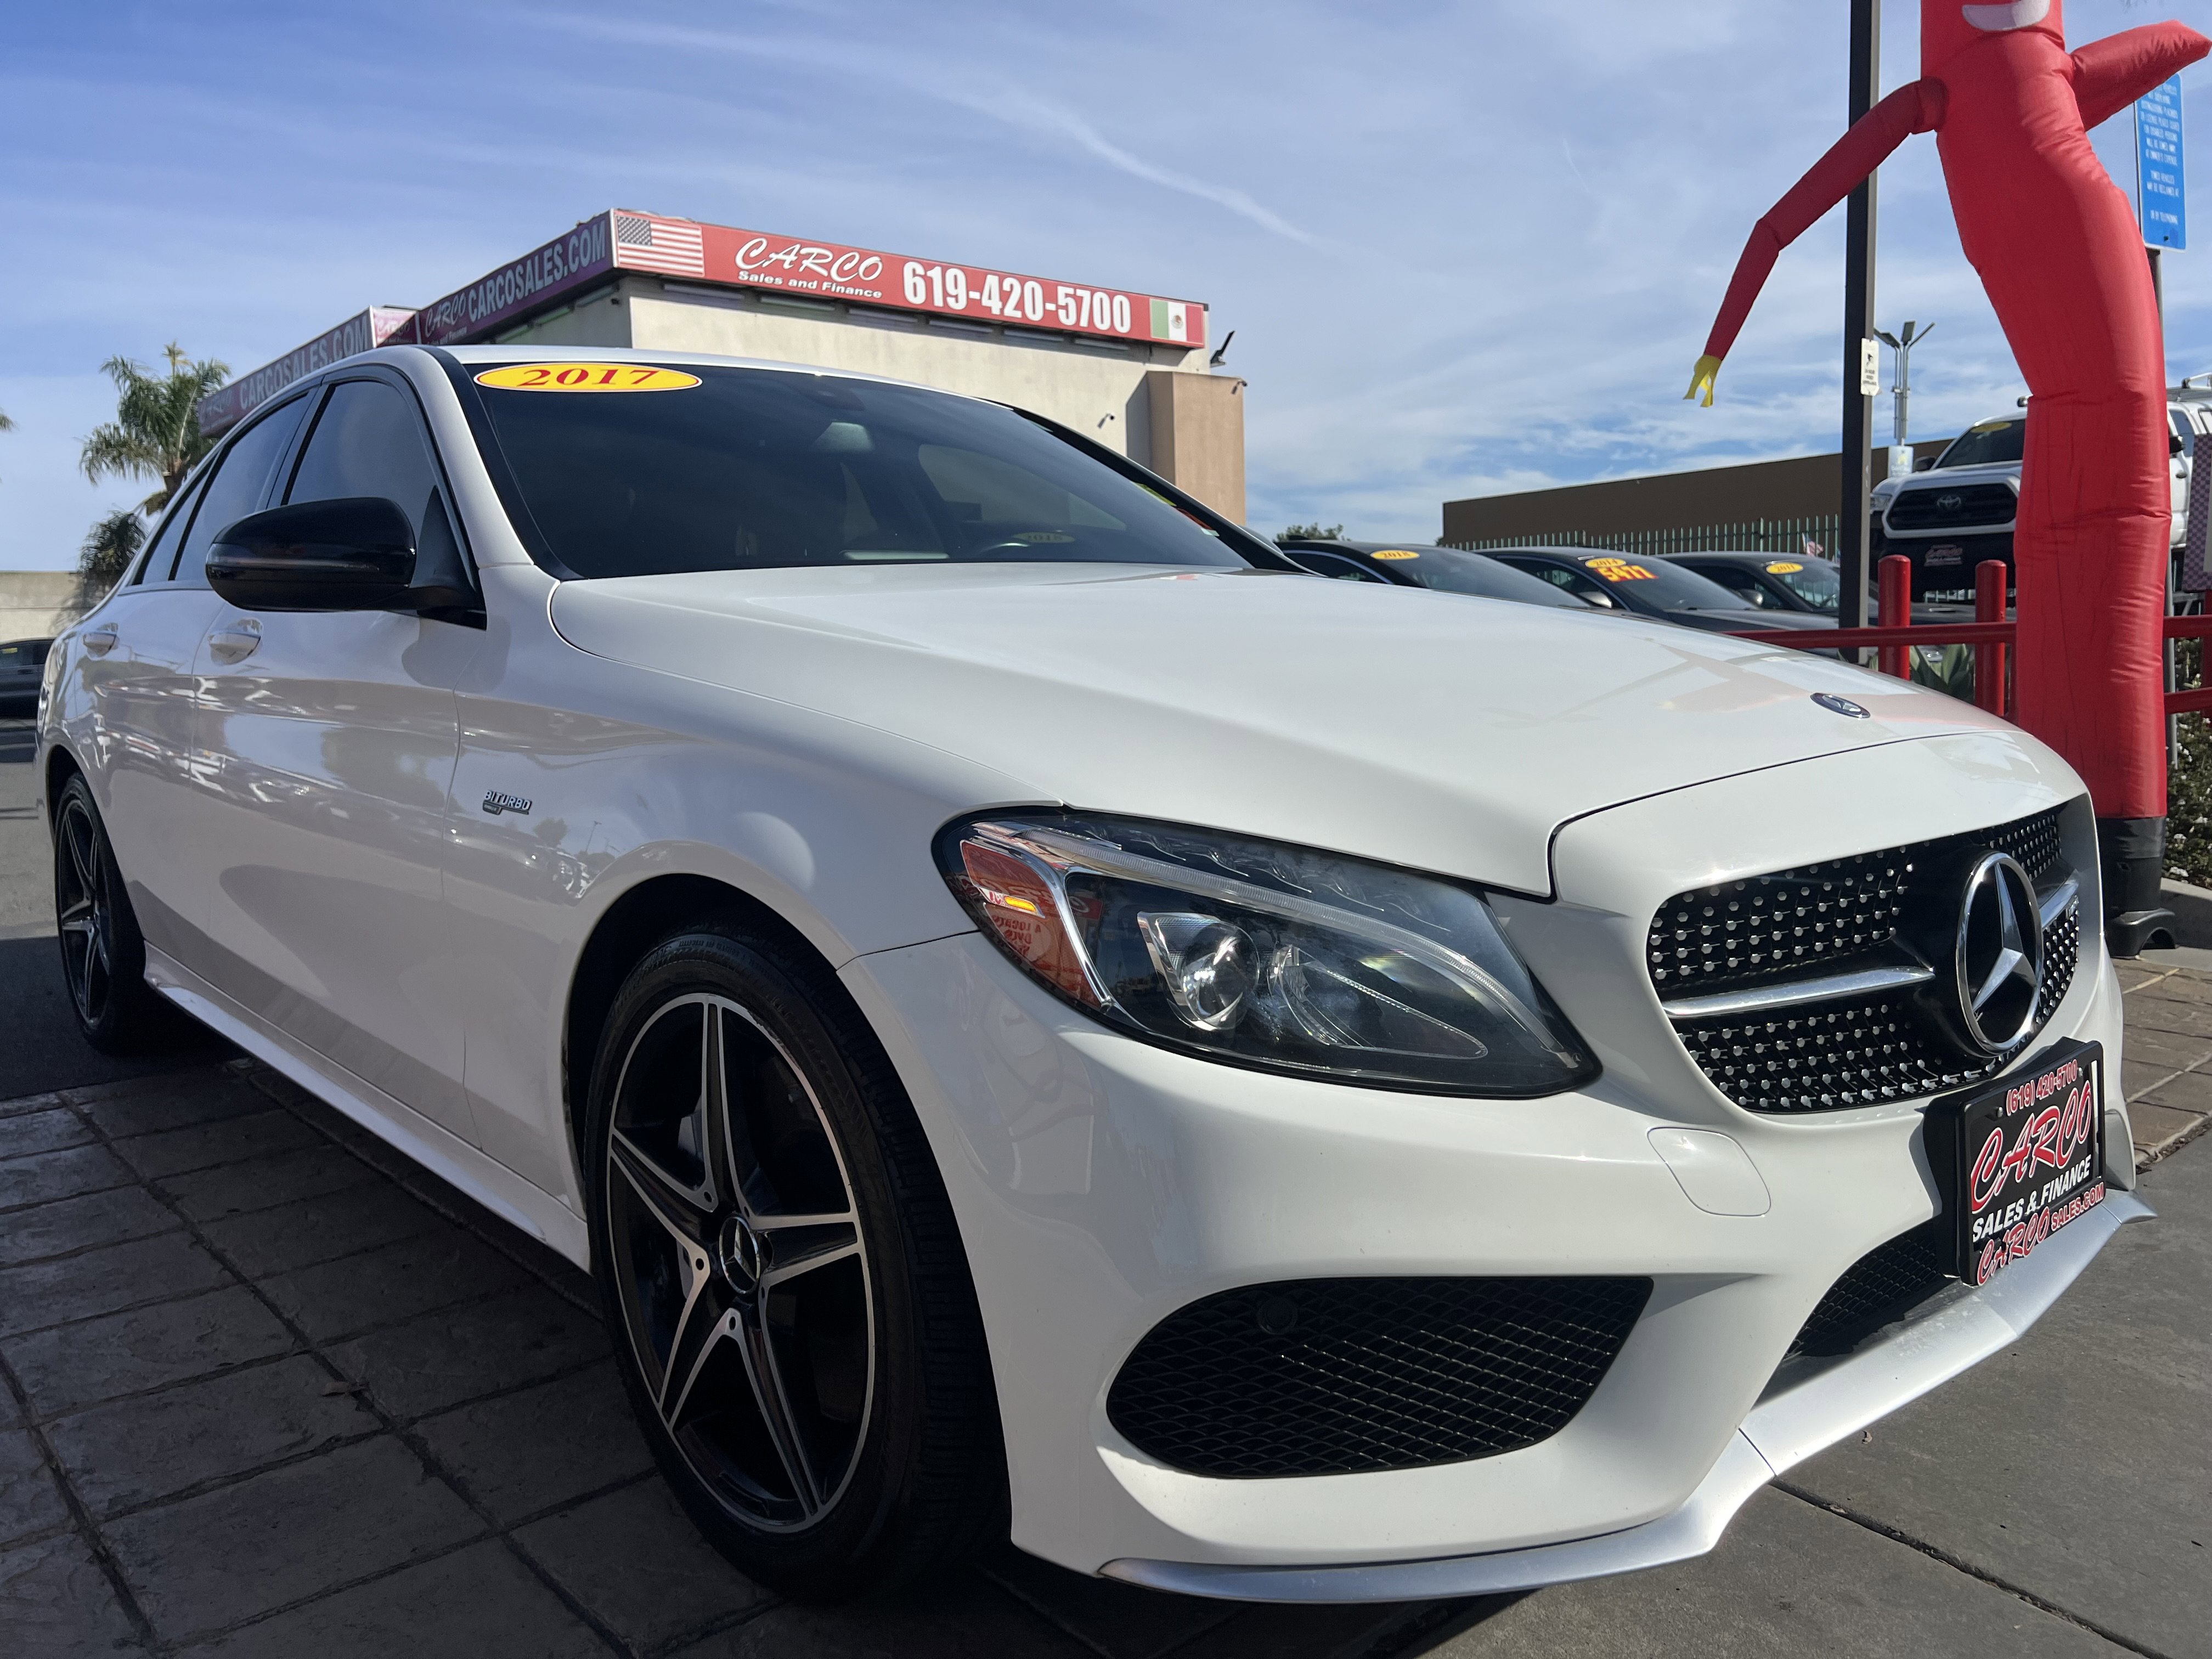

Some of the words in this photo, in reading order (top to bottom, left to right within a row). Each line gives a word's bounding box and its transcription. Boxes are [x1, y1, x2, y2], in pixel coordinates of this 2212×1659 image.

[469, 220, 606, 323] CARCOSALES.COM
[735, 238, 883, 282] CARCO
[738, 270, 783, 285] Sales
[788, 278, 819, 290] and
[822, 281, 883, 298] Finance
[425, 292, 466, 338] CARCO
[903, 261, 1131, 333] 619-420-5700
[517, 368, 659, 387] 2017
[484, 790, 532, 810] BITURBO
[2006, 1079, 2035, 1116] (619)
[2036, 1059, 2078, 1101] 420-5700
[1970, 1080, 2091, 1214] CARCO
[1973, 1198, 2024, 1243] SALES
[2026, 1190, 2038, 1216] &
[2040, 1154, 2091, 1206] FINANCE
[1977, 1206, 2050, 1286] CARCO
[2051, 1181, 2104, 1231] SALES.COM
